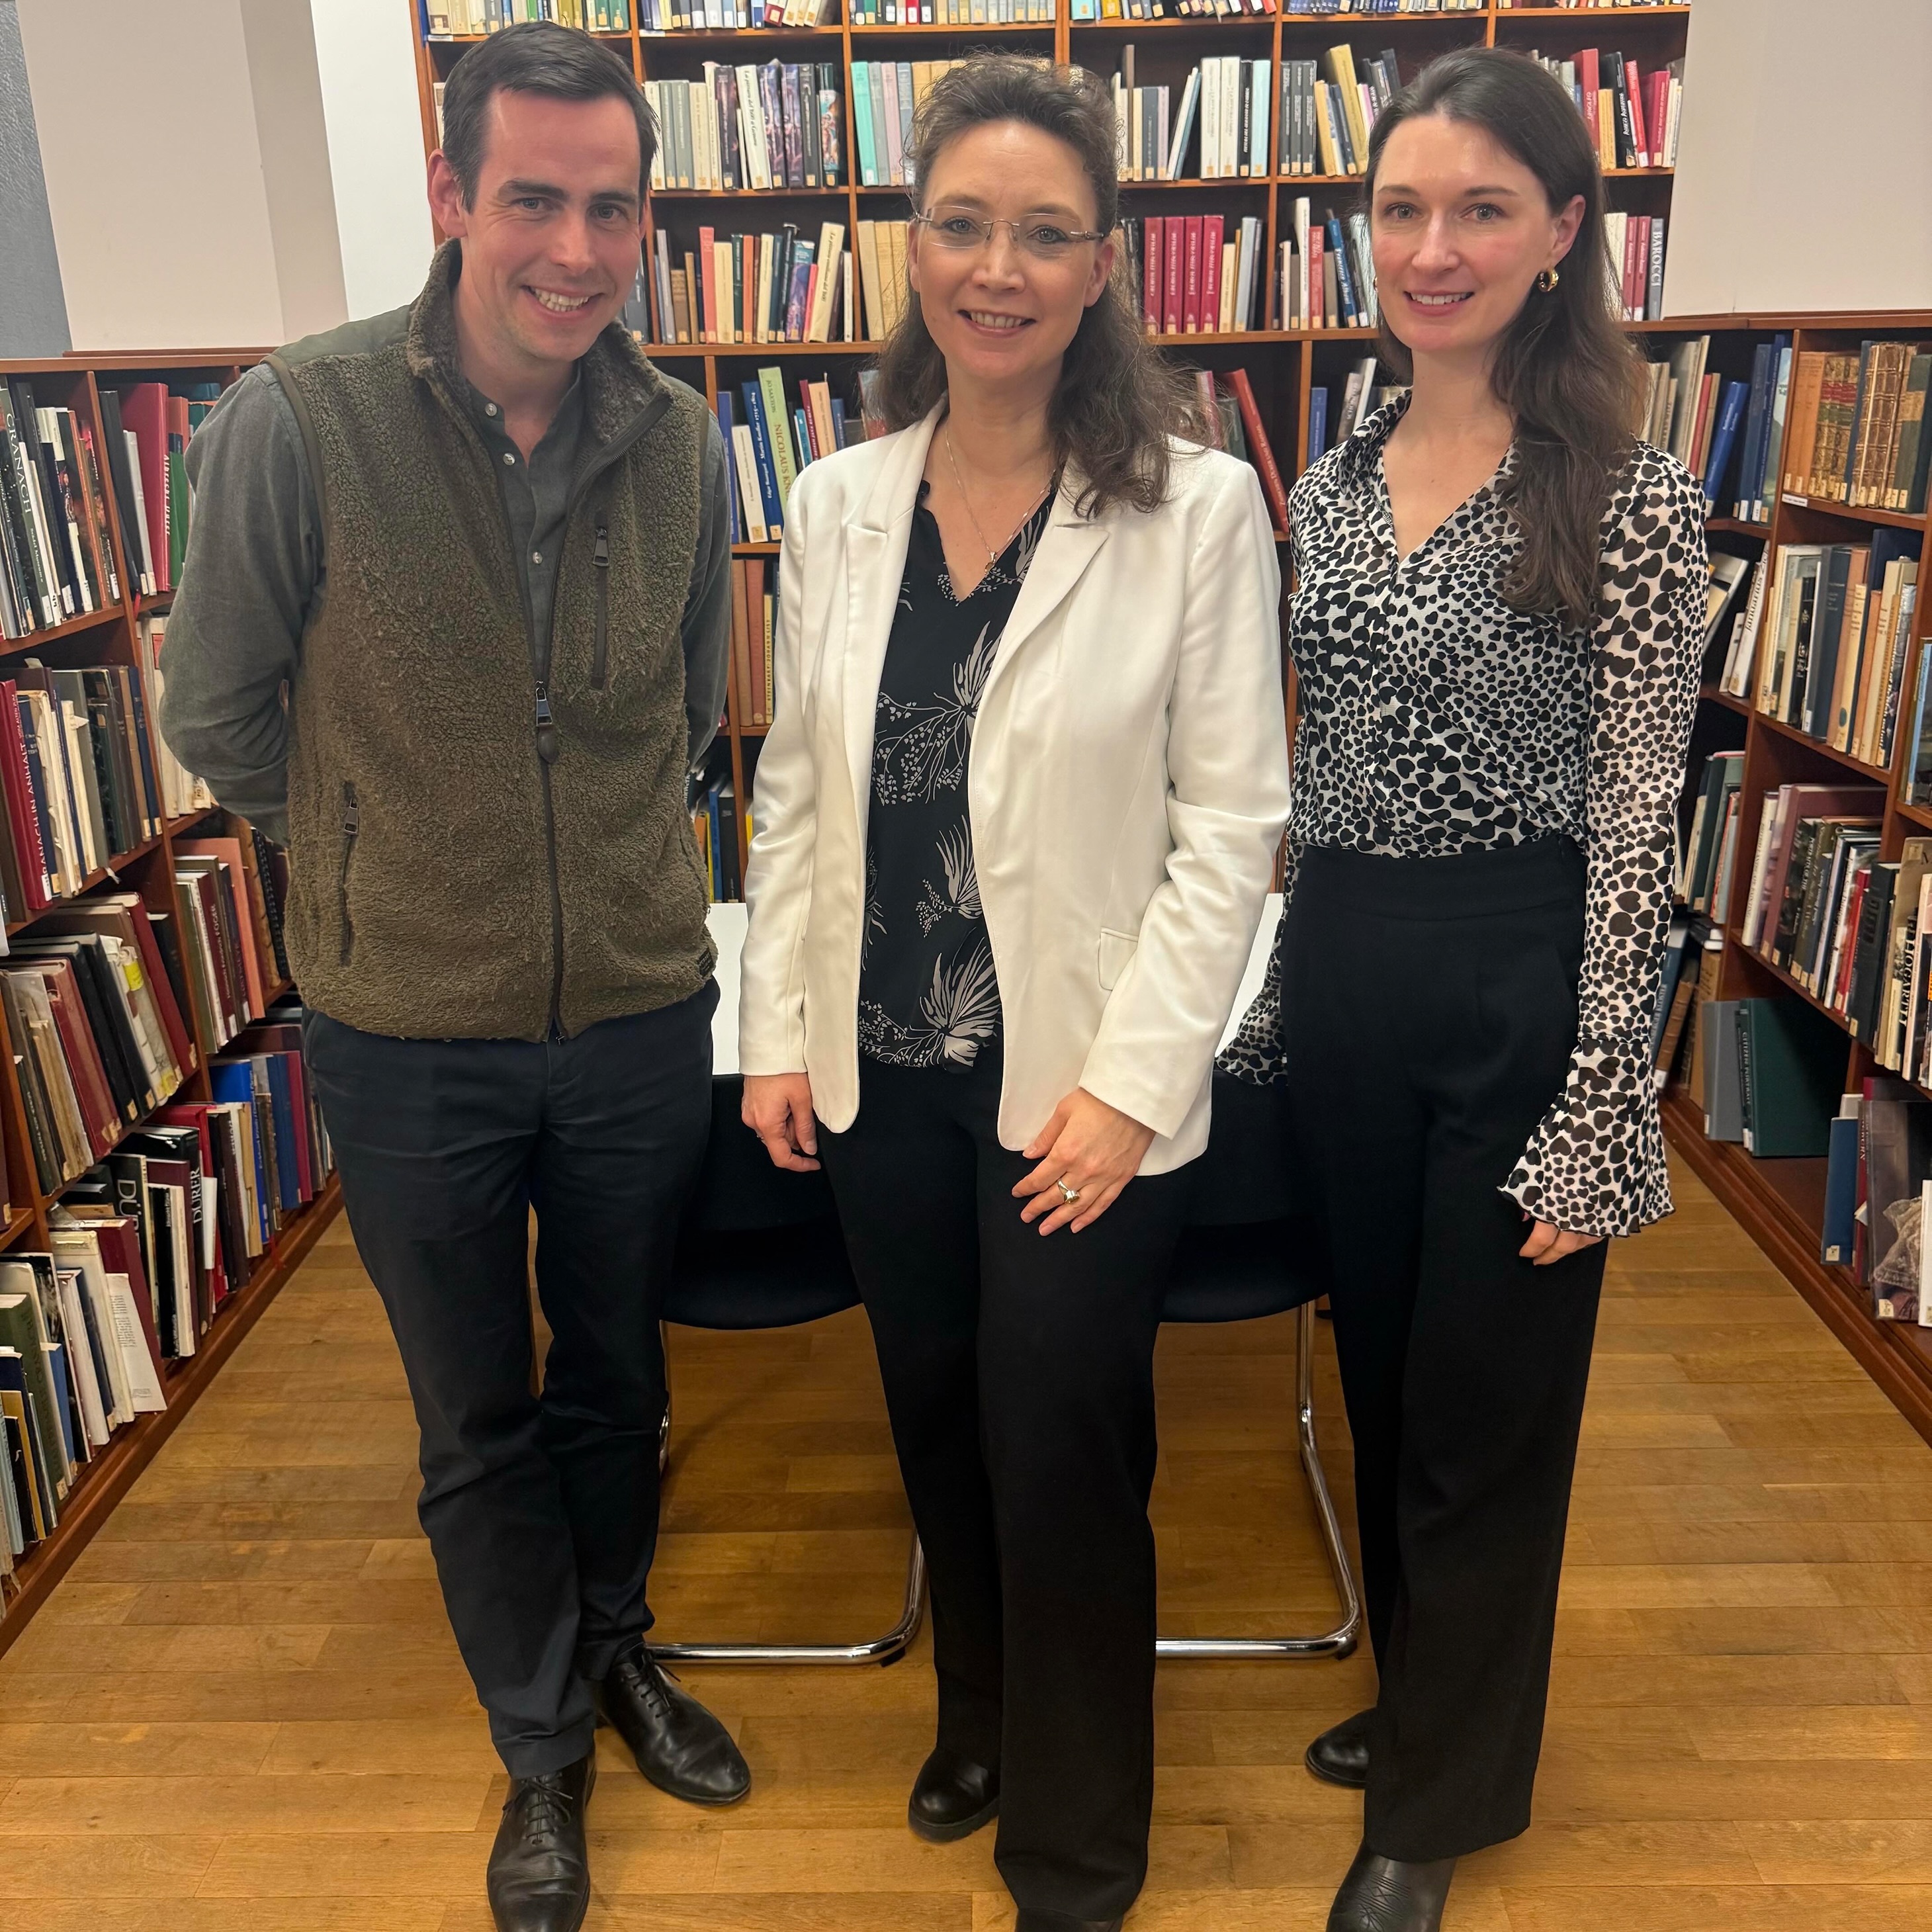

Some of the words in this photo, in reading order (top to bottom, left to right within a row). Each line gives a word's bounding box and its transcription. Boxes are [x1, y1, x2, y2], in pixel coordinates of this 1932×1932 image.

[1651, 231, 1663, 286] BAROCCI
[7, 414, 32, 513] CRANACH
[774, 423, 790, 474] NICOLAUS
[1745, 577, 1763, 632] Januarius
[20, 743, 34, 795] ANHALT
[32, 816, 48, 875] RANACH
[1898, 940, 1915, 1028] HOGARTH
